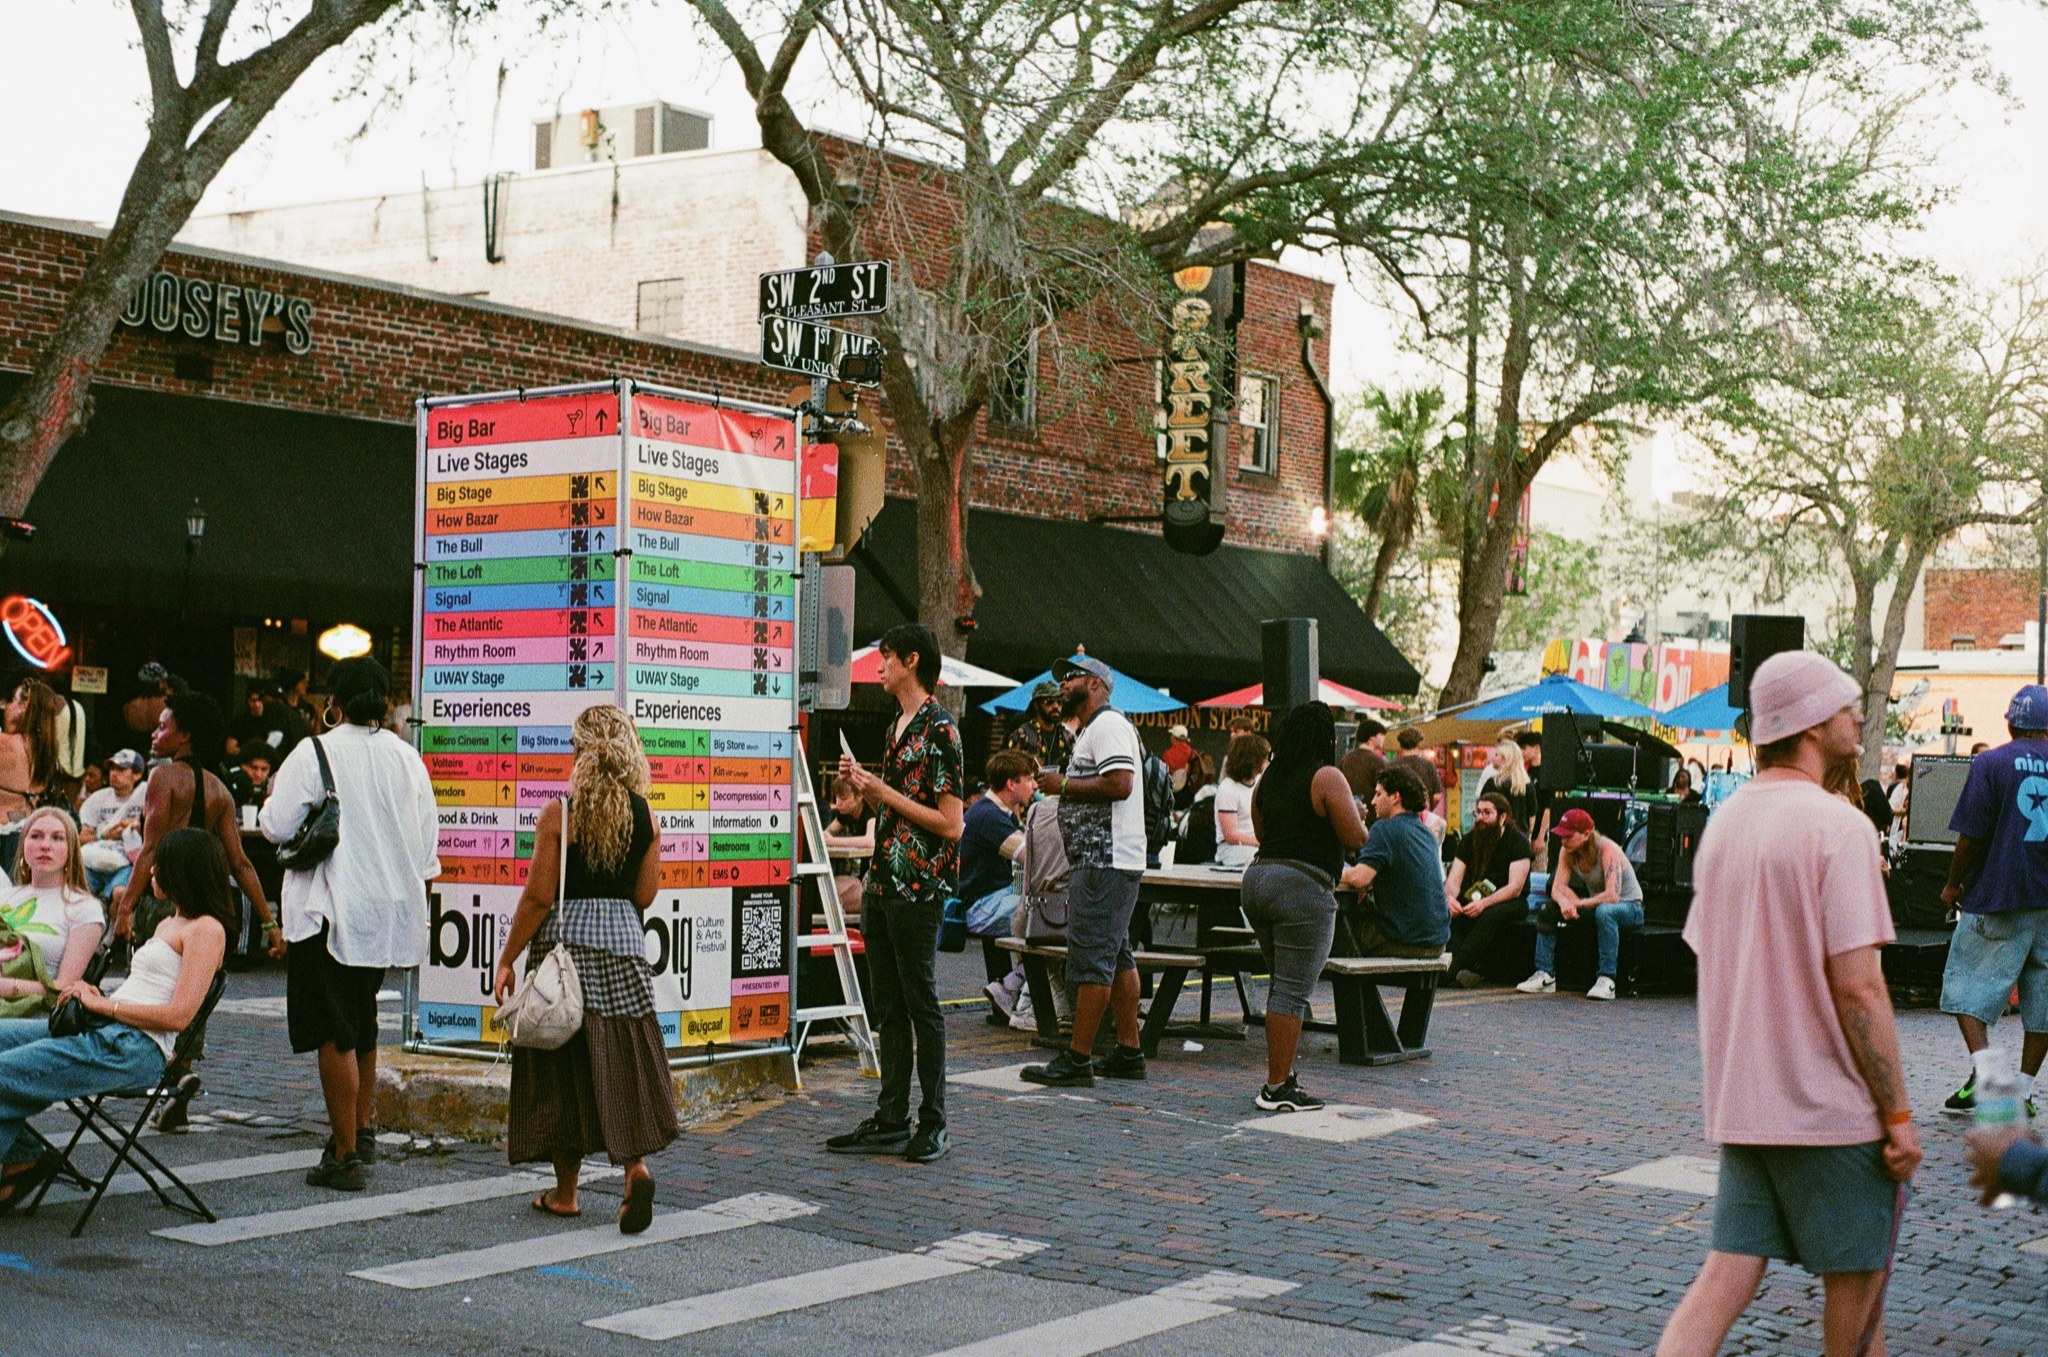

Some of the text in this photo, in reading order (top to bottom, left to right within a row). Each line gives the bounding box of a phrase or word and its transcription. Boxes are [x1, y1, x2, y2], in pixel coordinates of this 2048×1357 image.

[767, 264, 879, 309] SW 2ND ST
[119, 271, 313, 355] OOSEY'S
[787, 300, 845, 317] PLEASANT
[851, 299, 868, 312] ST
[771, 318, 803, 357] SW
[814, 326, 831, 360] 1ST
[783, 354, 839, 377] W UNIO
[437, 418, 496, 443] Big Bar
[639, 408, 691, 436] Big Bar
[437, 451, 528, 474] Live Stages
[638, 444, 719, 476] Live Stages
[437, 486, 492, 504] Big Stage
[638, 478, 688, 501] Big Stage
[436, 512, 498, 527] How Bazar
[637, 506, 694, 526] How Bazar
[436, 537, 483, 554] The Bull
[637, 533, 680, 551] The Bull
[435, 564, 483, 580] The Loft
[637, 561, 680, 578] The Loft
[435, 591, 472, 609] Signal
[636, 587, 670, 606] Signal
[2, 596, 71, 669] OPEN
[435, 616, 503, 632] The Atlantic
[637, 615, 698, 633] The Atlantic
[434, 644, 516, 661] Rhythm Room
[636, 642, 709, 662] Rhythm Room
[434, 670, 505, 687] UWAY Stage
[636, 670, 699, 690] UWAY Stage
[433, 698, 531, 722] Experiences
[635, 698, 721, 723] Experiences
[1133, 706, 1201, 729] OURBON
[432, 735, 490, 746] Micro Cinema
[521, 734, 535, 748] Big
[536, 735, 559, 746] Store
[640, 735, 686, 749] icro Cinema
[713, 739, 725, 752] Big
[726, 739, 746, 750] Store
[431, 757, 464, 768] Voltaire
[521, 763, 535, 774] Kin
[713, 765, 725, 777] Kin
[2014, 753, 2048, 774] nin
[433, 786, 466, 797] Vendors
[520, 787, 570, 800] Decompres
[713, 790, 767, 803] Decompression
[438, 811, 498, 825] ood & Drink
[660, 815, 695, 828] & Drink
[712, 815, 762, 828] Information
[438, 837, 477, 848] ood Court
[660, 842, 676, 852] ourt
[713, 842, 750, 852] Restrooms
[712, 869, 729, 880] EMS
[695, 916, 725, 928] Culture
[695, 928, 722, 940] & Arts
[429, 892, 496, 996] big
[696, 939, 727, 954] Festival
[741, 981, 781, 991] PRESENTED BY
